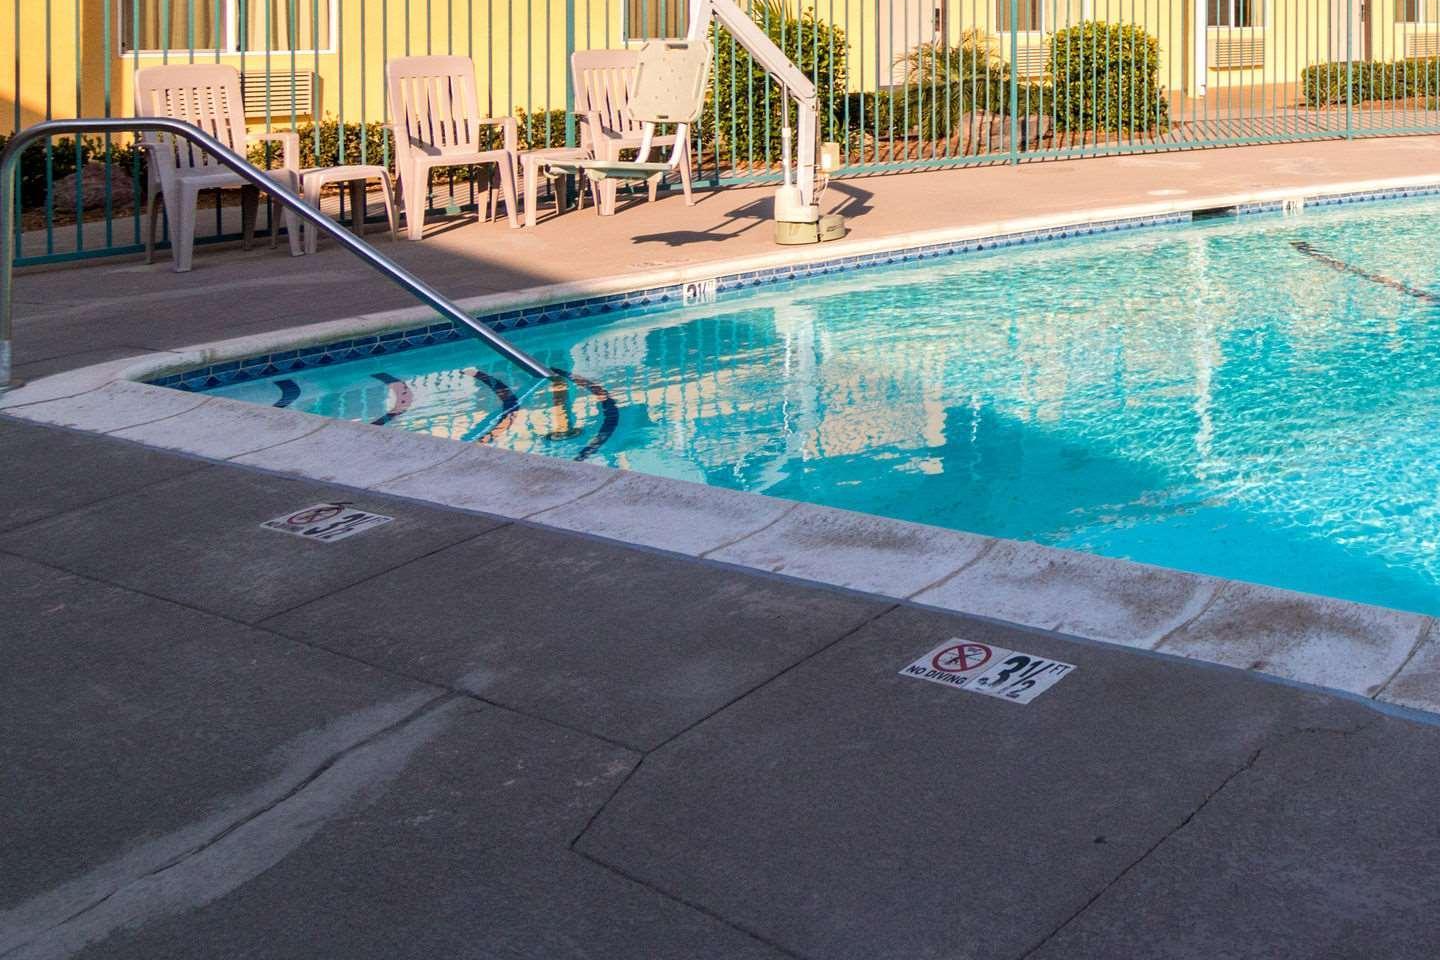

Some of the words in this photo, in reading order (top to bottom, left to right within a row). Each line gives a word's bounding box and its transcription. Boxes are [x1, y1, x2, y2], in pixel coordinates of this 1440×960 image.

[905, 665, 927, 675] NO
[925, 671, 968, 685] DIVING
[1048, 664, 1071, 675] FT
